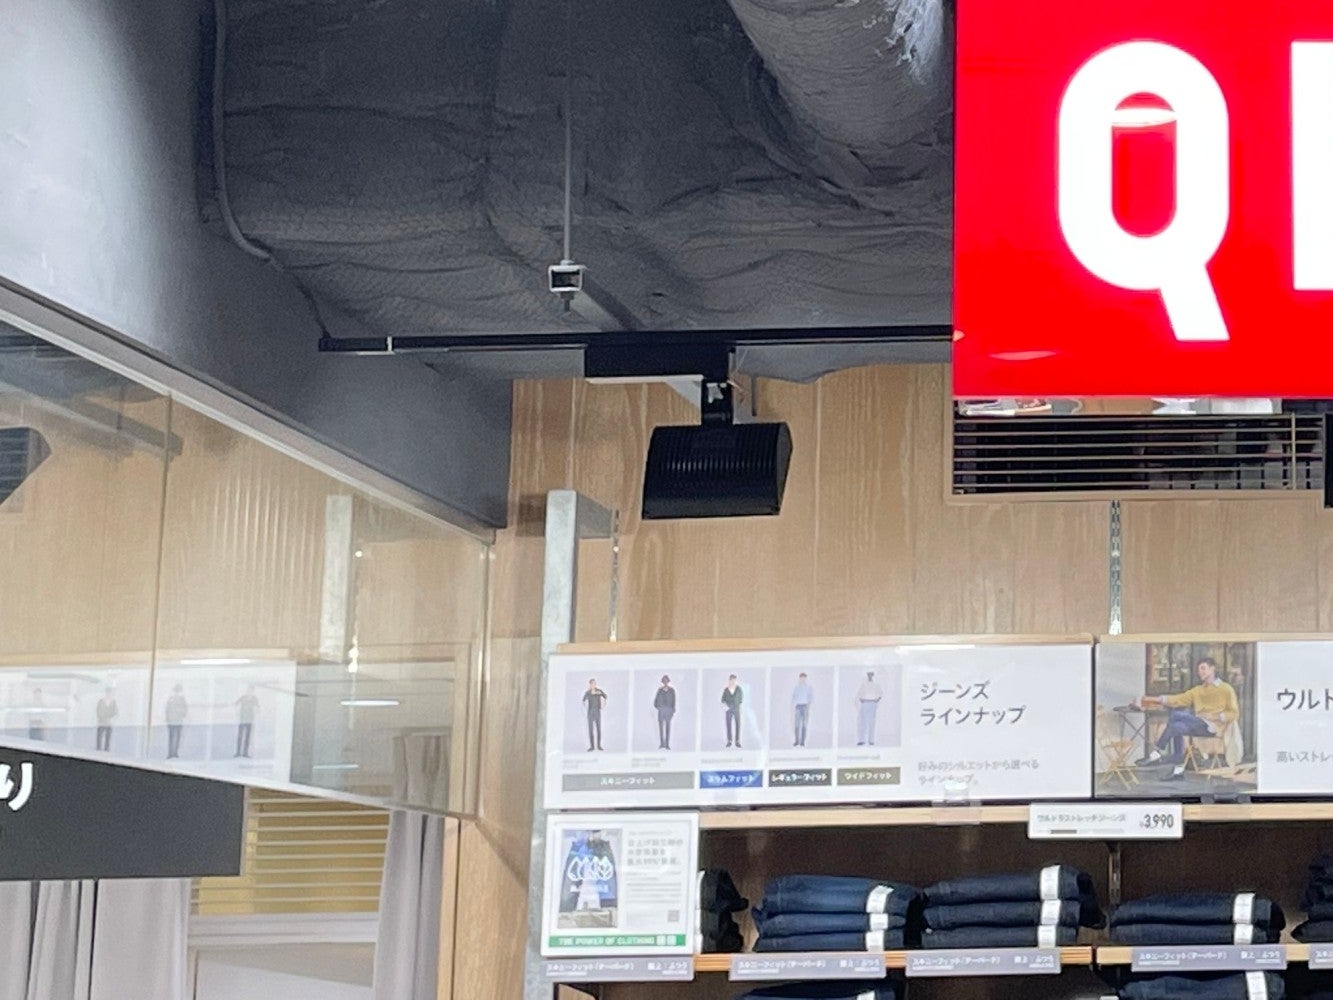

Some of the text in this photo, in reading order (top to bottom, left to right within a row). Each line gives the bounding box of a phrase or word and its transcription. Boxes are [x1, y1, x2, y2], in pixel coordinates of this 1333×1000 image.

[920, 680, 991, 701] ジーンズ
[920, 705, 1027, 726] ラインナップ
